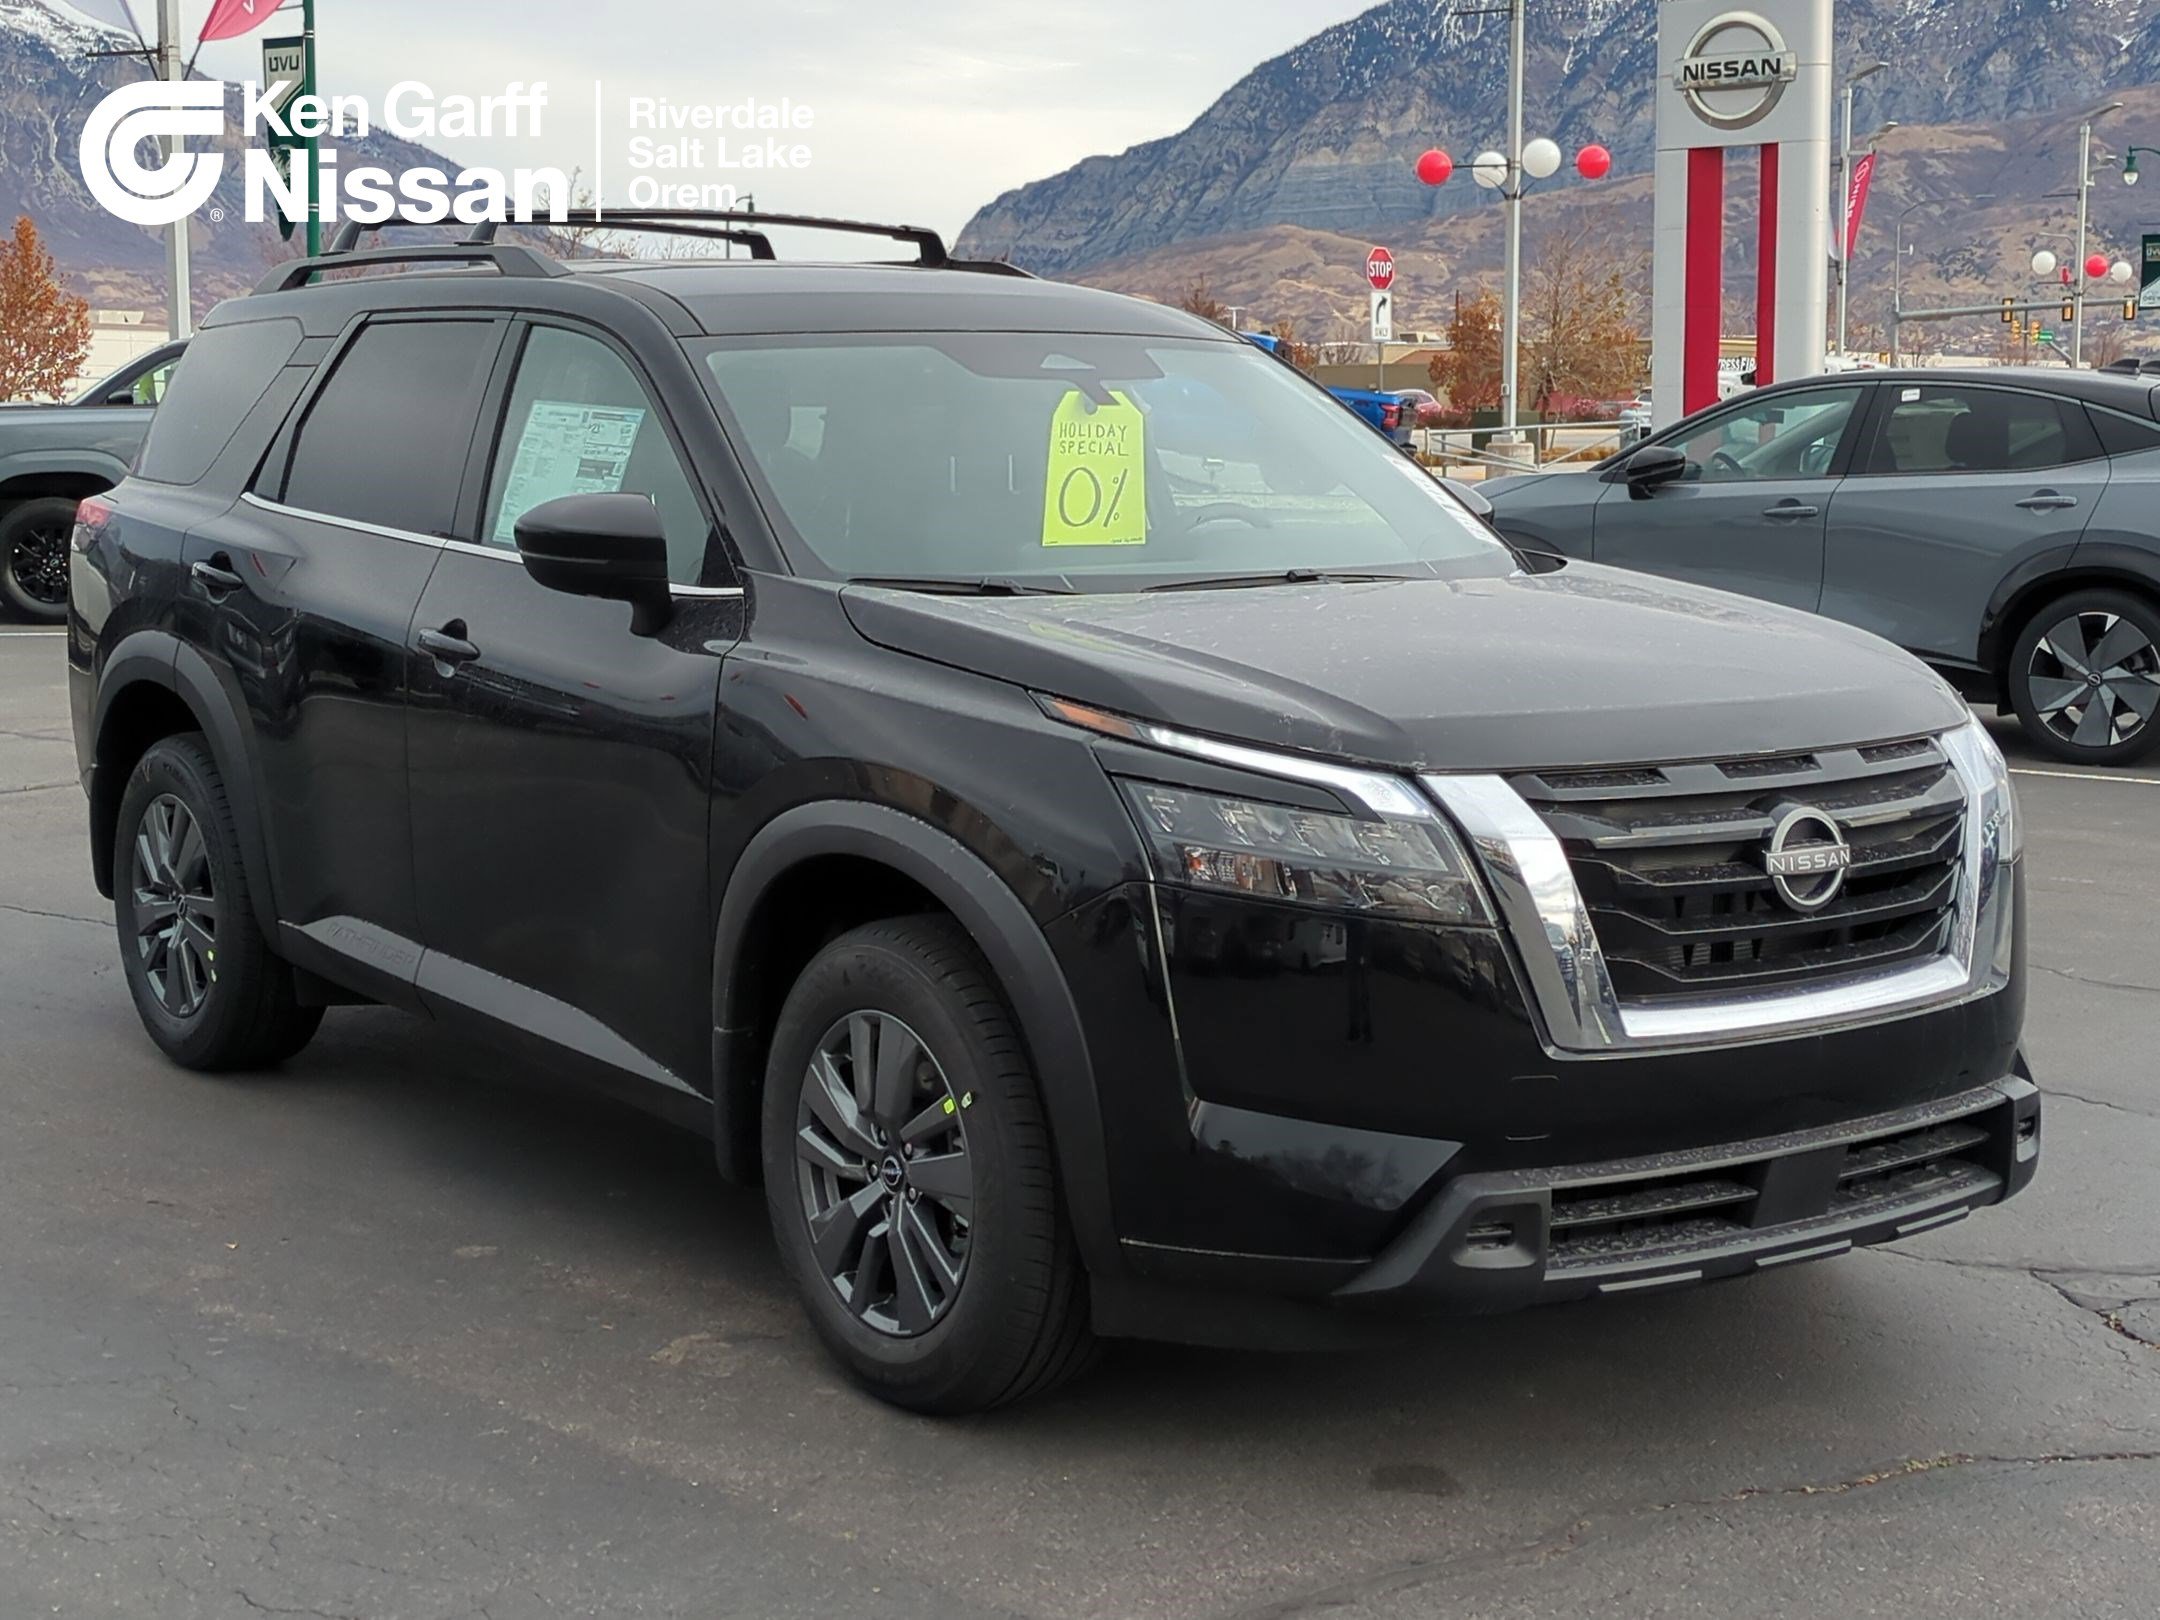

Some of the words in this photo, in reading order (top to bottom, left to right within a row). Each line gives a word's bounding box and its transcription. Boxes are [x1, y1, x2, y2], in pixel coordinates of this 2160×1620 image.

[268, 54, 300, 72] UVU
[1683, 57, 1781, 82] NISSAN
[1369, 261, 1393, 278] STOP
[1059, 422, 1128, 442] HOLIDAY
[1059, 440, 1129, 457] SPECIAL
[1058, 466, 1129, 528] 0%
[1769, 848, 1850, 873] NISSAN
